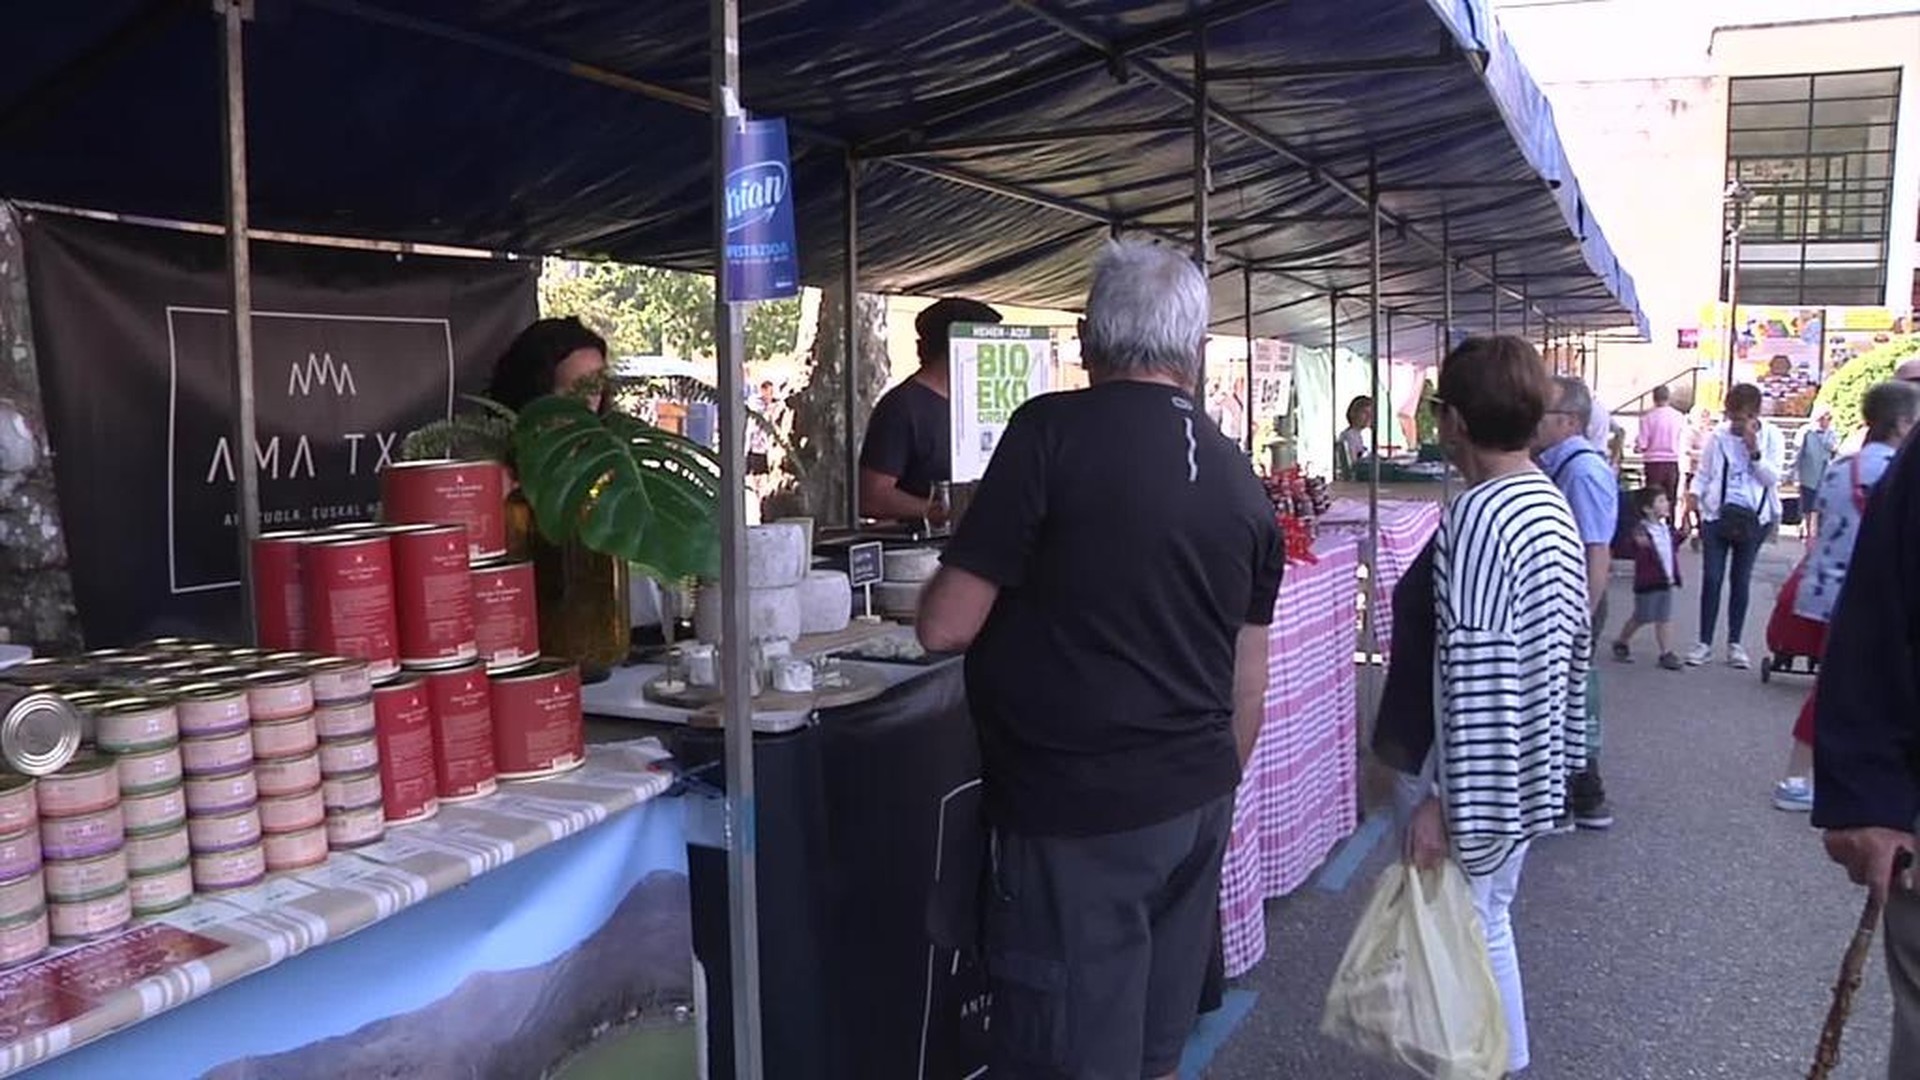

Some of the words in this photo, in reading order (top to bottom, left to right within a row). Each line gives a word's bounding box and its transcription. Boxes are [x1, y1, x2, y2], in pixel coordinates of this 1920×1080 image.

[977, 343, 1030, 378] BIO
[977, 380, 1029, 410] EKO
[977, 410, 1009, 424] ORGA
[206, 434, 316, 483] AMA
[344, 431, 398, 475] TX
